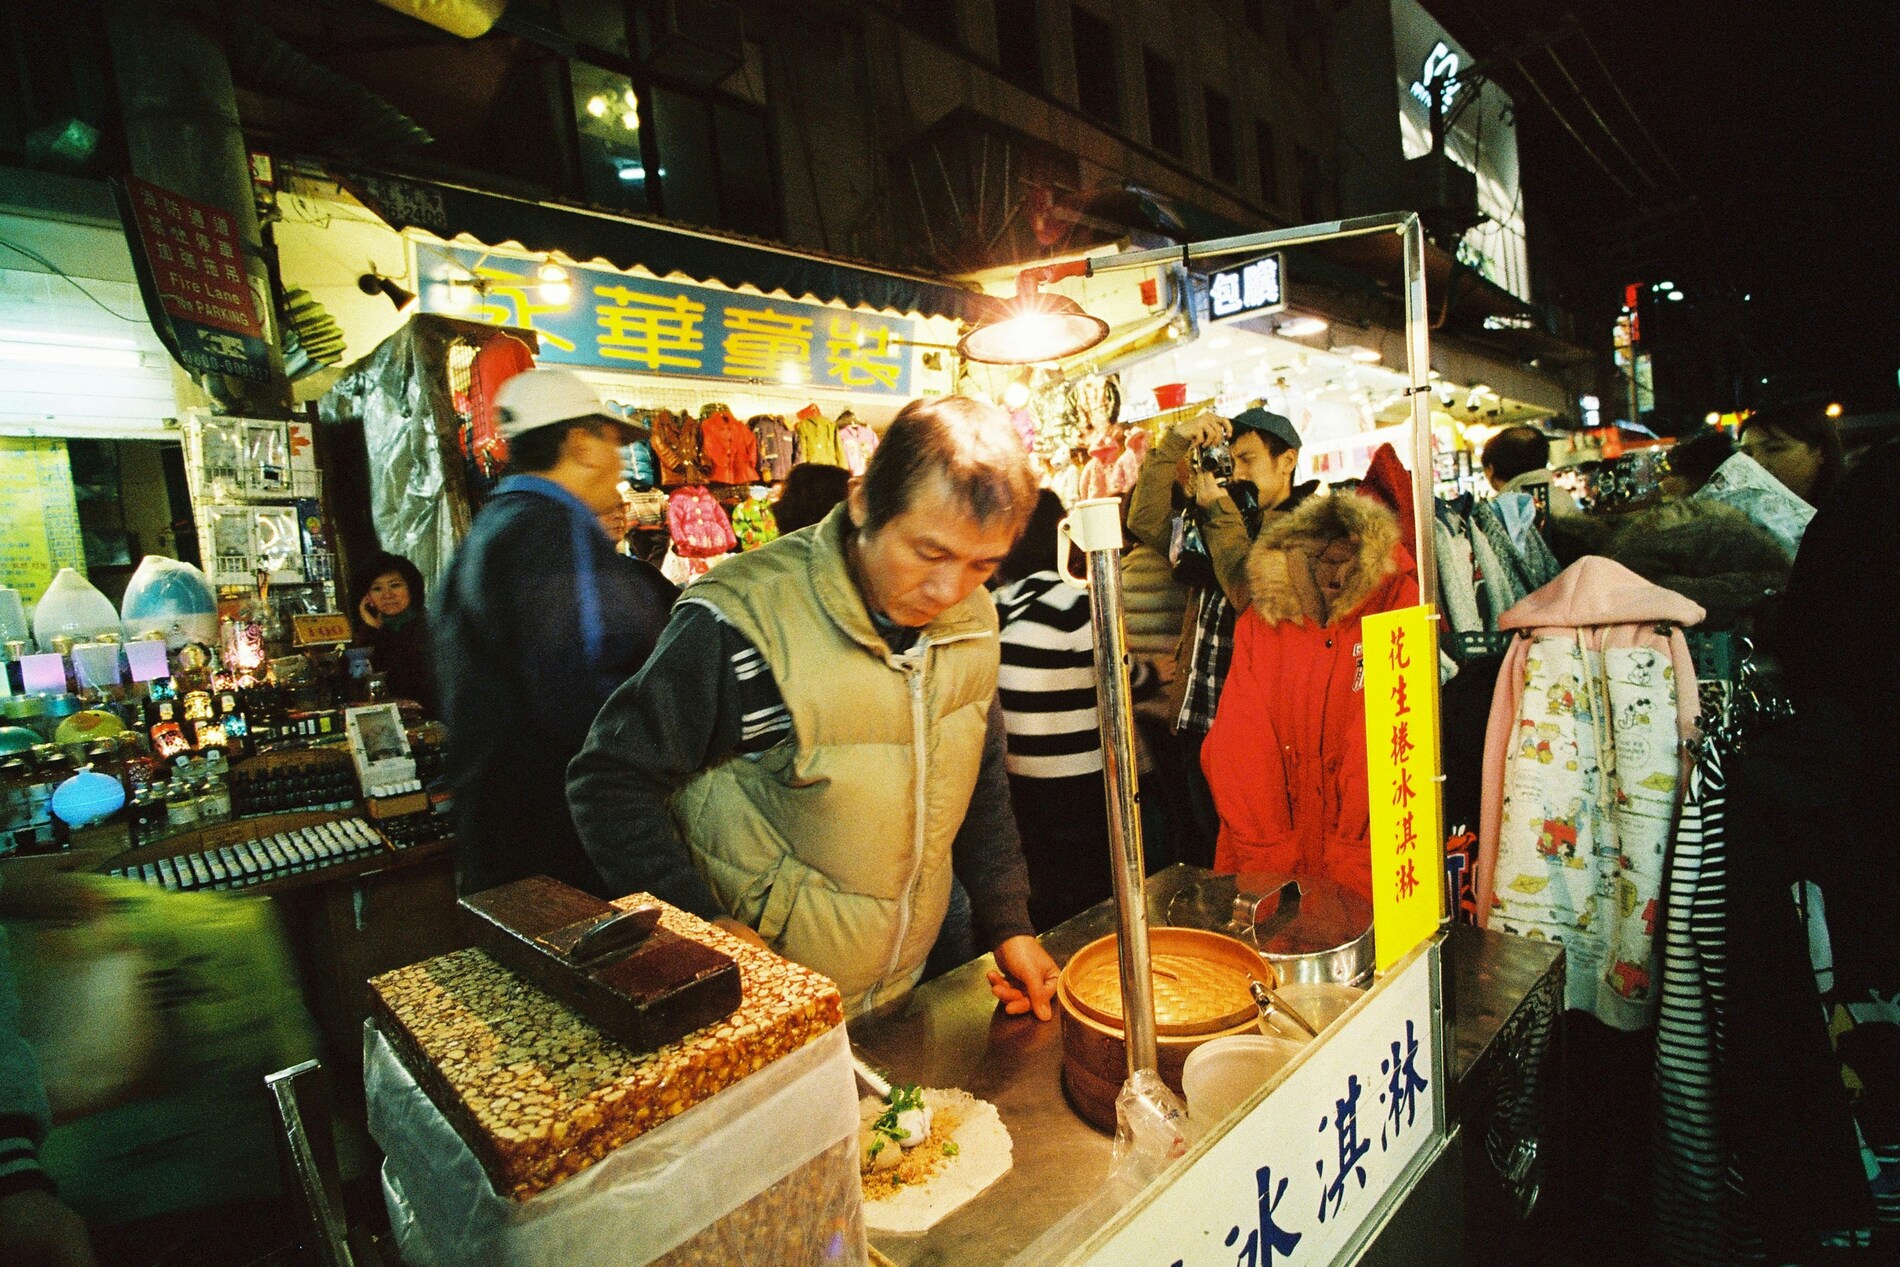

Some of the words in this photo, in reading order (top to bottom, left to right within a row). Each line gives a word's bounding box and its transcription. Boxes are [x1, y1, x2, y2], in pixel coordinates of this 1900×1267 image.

[147, 214, 234, 258] 禁止停車
[156, 240, 241, 283] 加強拖吊
[169, 271, 201, 293] Fire
[204, 282, 241, 305] Lane
[195, 299, 250, 327] PARKING
[1388, 626, 1419, 903] 花生捲冰淇淋
[1170, 1019, 1428, 1267] 冰淇淋
